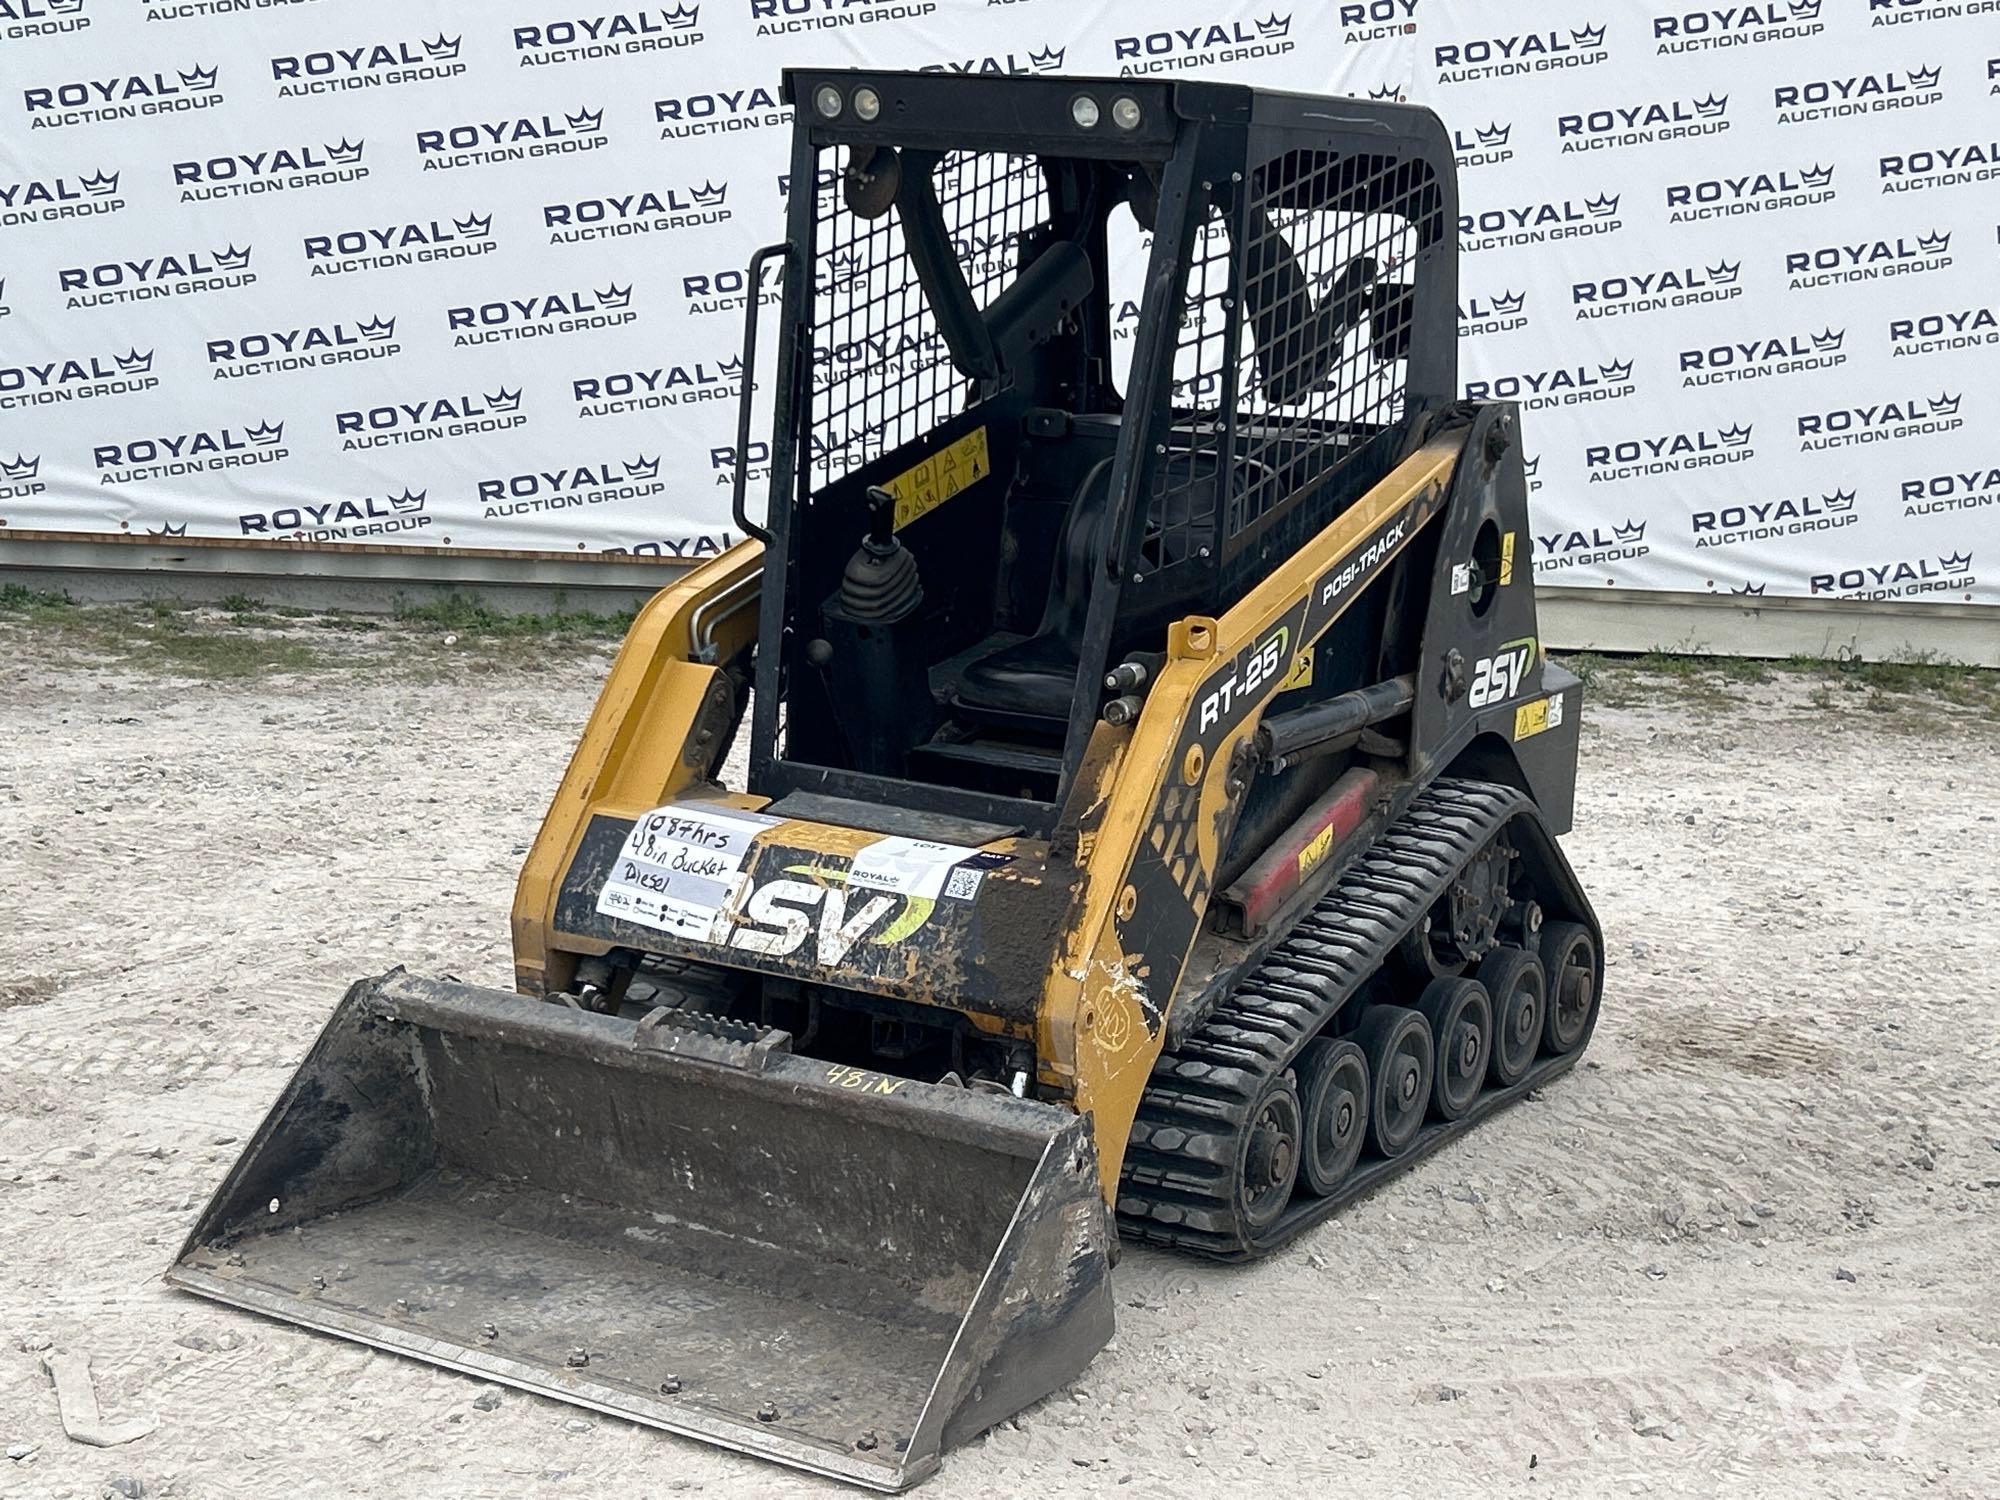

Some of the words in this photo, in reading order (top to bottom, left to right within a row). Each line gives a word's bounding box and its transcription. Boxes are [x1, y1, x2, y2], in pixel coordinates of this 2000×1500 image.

[146, 0, 250, 21] AUCTION
[757, 13, 854, 36] AUCTION
[860, 3, 936, 23] GROUP
[1654, 4, 1787, 38] ROYAL
[1872, 5, 1961, 27] AUCTION
[8, 18, 90, 38] GROUP
[514, 12, 662, 49] ROYAL
[1115, 22, 1255, 60] ROYAL
[1657, 33, 1748, 55] AUCTION
[1753, 23, 1824, 42] GROUP
[271, 43, 423, 80] ROYAL
[520, 43, 620, 67] AUCTION
[626, 33, 704, 53] GROUP
[1120, 53, 1214, 77] AUCTION
[1220, 42, 1294, 62] GROUP
[1435, 32, 1570, 67] ROYAL
[279, 74, 381, 98] AUCTION
[386, 64, 466, 84] GROUP
[1438, 62, 1530, 84] AUCTION
[1536, 52, 1608, 71] GROUP
[24, 74, 179, 111] ROYAL
[1775, 73, 1906, 108] ROYAL
[32, 105, 136, 129] AUCTION
[141, 95, 223, 115] GROUP
[1558, 102, 1692, 137] ROYAL
[1778, 103, 1867, 124] AUCTION
[1872, 92, 1942, 111] GROUP
[417, 116, 566, 153] ROYAL
[661, 117, 759, 140] AUCTION
[1562, 131, 1653, 153] AUCTION
[1659, 121, 1730, 140] GROUP
[173, 148, 326, 185] ROYAL
[424, 147, 524, 171] AUCTION
[529, 137, 608, 157] GROUP
[1880, 143, 2000, 178] ROYAL
[181, 179, 283, 203] AUCTION
[288, 168, 369, 188] GROUP
[1667, 172, 1799, 207] ROYAL
[1882, 172, 1971, 194] AUCTION
[43, 200, 125, 220] GROUP
[544, 190, 690, 227] ROYAL
[1458, 201, 1584, 235] ROYAL
[1670, 201, 1760, 223] AUCTION
[1765, 191, 1835, 210] GROUP
[304, 222, 454, 259] ROYAL
[550, 221, 649, 244] AUCTION
[654, 210, 731, 230] GROUP
[1550, 220, 1622, 240] GROUP
[59, 254, 213, 292] ROYAL
[311, 253, 412, 276] AUCTION
[418, 242, 497, 262] GROUP
[1786, 239, 1916, 274] ROYAL
[1789, 268, 1877, 290] AUCTION
[1883, 257, 1952, 276] GROUP
[67, 285, 170, 309] AUCTION
[176, 274, 256, 294] GROUP
[1573, 269, 1705, 304] ROYAL
[1576, 298, 1666, 320] AUCTION
[1672, 287, 1742, 306] GROUP
[448, 293, 595, 330] ROYAL
[1458, 318, 1528, 337] GROUP
[207, 325, 358, 362] ROYAL
[454, 323, 554, 347] AUCTION
[559, 312, 637, 332] GROUP
[1893, 335, 1981, 357] AUCTION
[214, 356, 316, 380] AUCTION
[321, 344, 400, 365] GROUP
[1680, 336, 1810, 372] ROYAL
[1683, 365, 1771, 388] AUCTION
[1777, 354, 1846, 374] GROUP
[77, 377, 159, 398] GROUP
[573, 364, 718, 401] ROYAL
[1466, 367, 1598, 400] ROYAL
[1564, 385, 1635, 405] GROUP
[336, 396, 485, 434] ROYAL
[579, 394, 677, 418] AUCTION
[1798, 401, 1927, 436] ROYAL
[94, 430, 246, 468] ROYAL
[343, 427, 443, 451] AUCTION
[448, 416, 527, 436] GROUP
[1586, 432, 1717, 467] ROYAL
[1801, 430, 1889, 452] AUCTION
[1894, 419, 1962, 438] GROUP
[101, 461, 203, 485] AUCTION
[209, 449, 288, 470] GROUP
[478, 465, 624, 502] ROYAL
[1590, 460, 1679, 483] AUCTION
[1684, 450, 1753, 469] GROUP
[239, 498, 389, 535] ROYAL
[484, 495, 583, 518] AUCTION
[588, 483, 664, 503] GROUP
[1692, 497, 1822, 532] ROYAL
[1904, 495, 1992, 517] AUCTION
[352, 515, 431, 536] GROUP
[1530, 529, 1612, 556] YAL
[1695, 526, 1783, 548] AUCTION
[1789, 515, 1858, 534] GROUP
[1322, 520, 1405, 605] POSI-TRACK
[1578, 546, 1649, 565] GROUP
[1810, 559, 1939, 594] ROYAL
[1906, 577, 1976, 595] GROUP
[1200, 640, 1279, 735] RT-25
[624, 862, 670, 893] Diesel
[672, 847, 728, 876] Bucket
[852, 869, 890, 883] ROYAL
